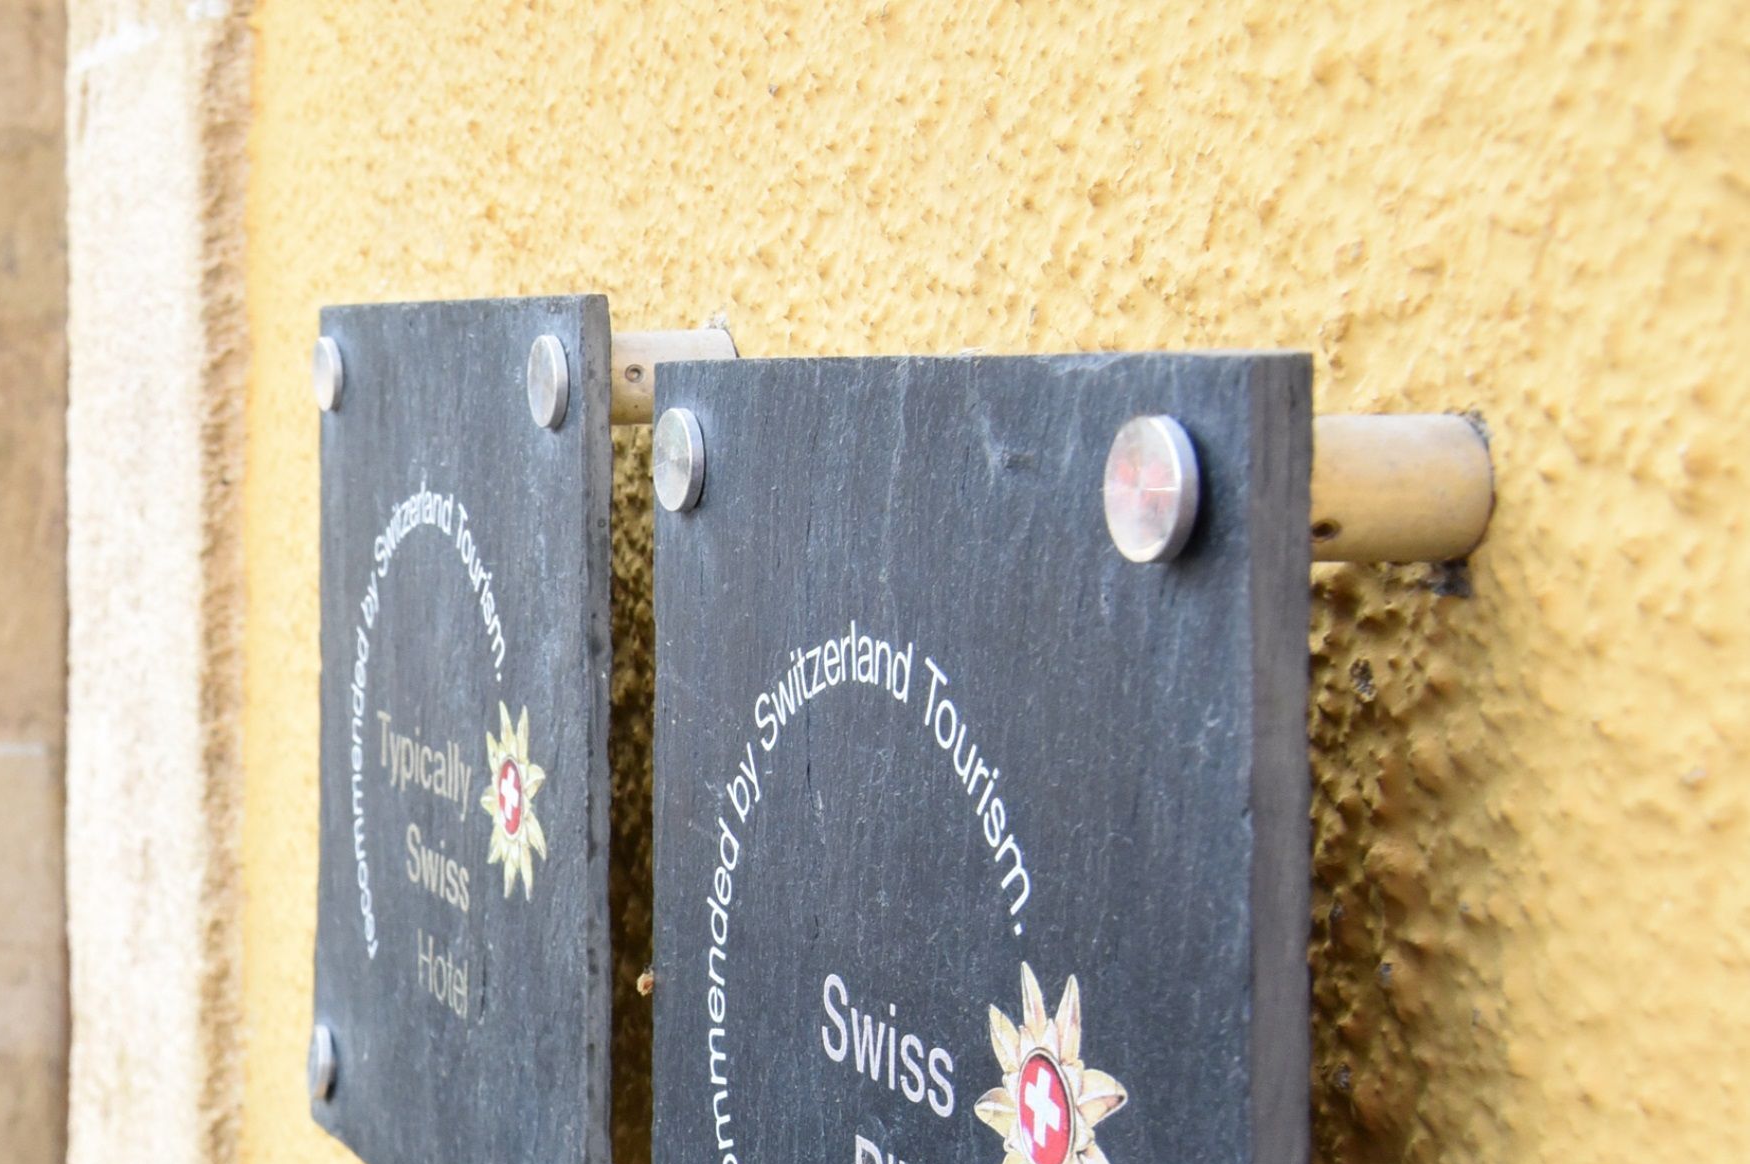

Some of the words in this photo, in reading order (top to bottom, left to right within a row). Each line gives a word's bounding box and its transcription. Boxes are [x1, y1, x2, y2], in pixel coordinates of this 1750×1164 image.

[360, 571, 381, 629] by
[373, 480, 454, 579] Switzerland
[376, 710, 472, 823] Typically
[726, 742, 764, 824] by
[753, 619, 914, 753] Switzerland
[405, 822, 470, 914] Swiss
[417, 927, 469, 1020] Hotel
[820, 972, 956, 1119] Swiss
